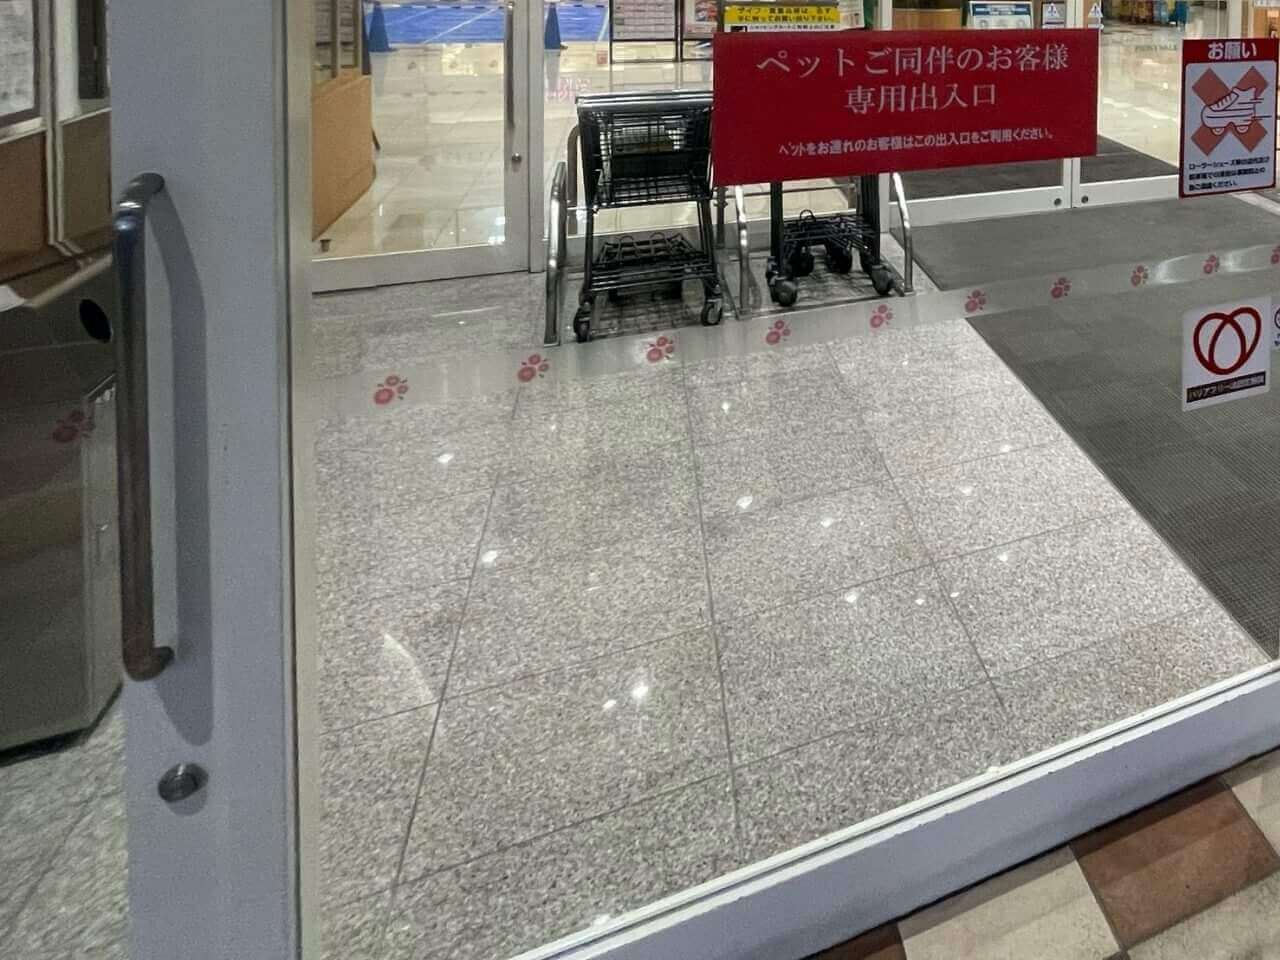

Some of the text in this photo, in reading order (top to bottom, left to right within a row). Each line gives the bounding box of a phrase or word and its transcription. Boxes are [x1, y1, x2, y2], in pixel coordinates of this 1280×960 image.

[757, 43, 1070, 78] ペットご同伴のお客様
[1208, 41, 1257, 60] お願い
[845, 82, 997, 115] 専用出入口
